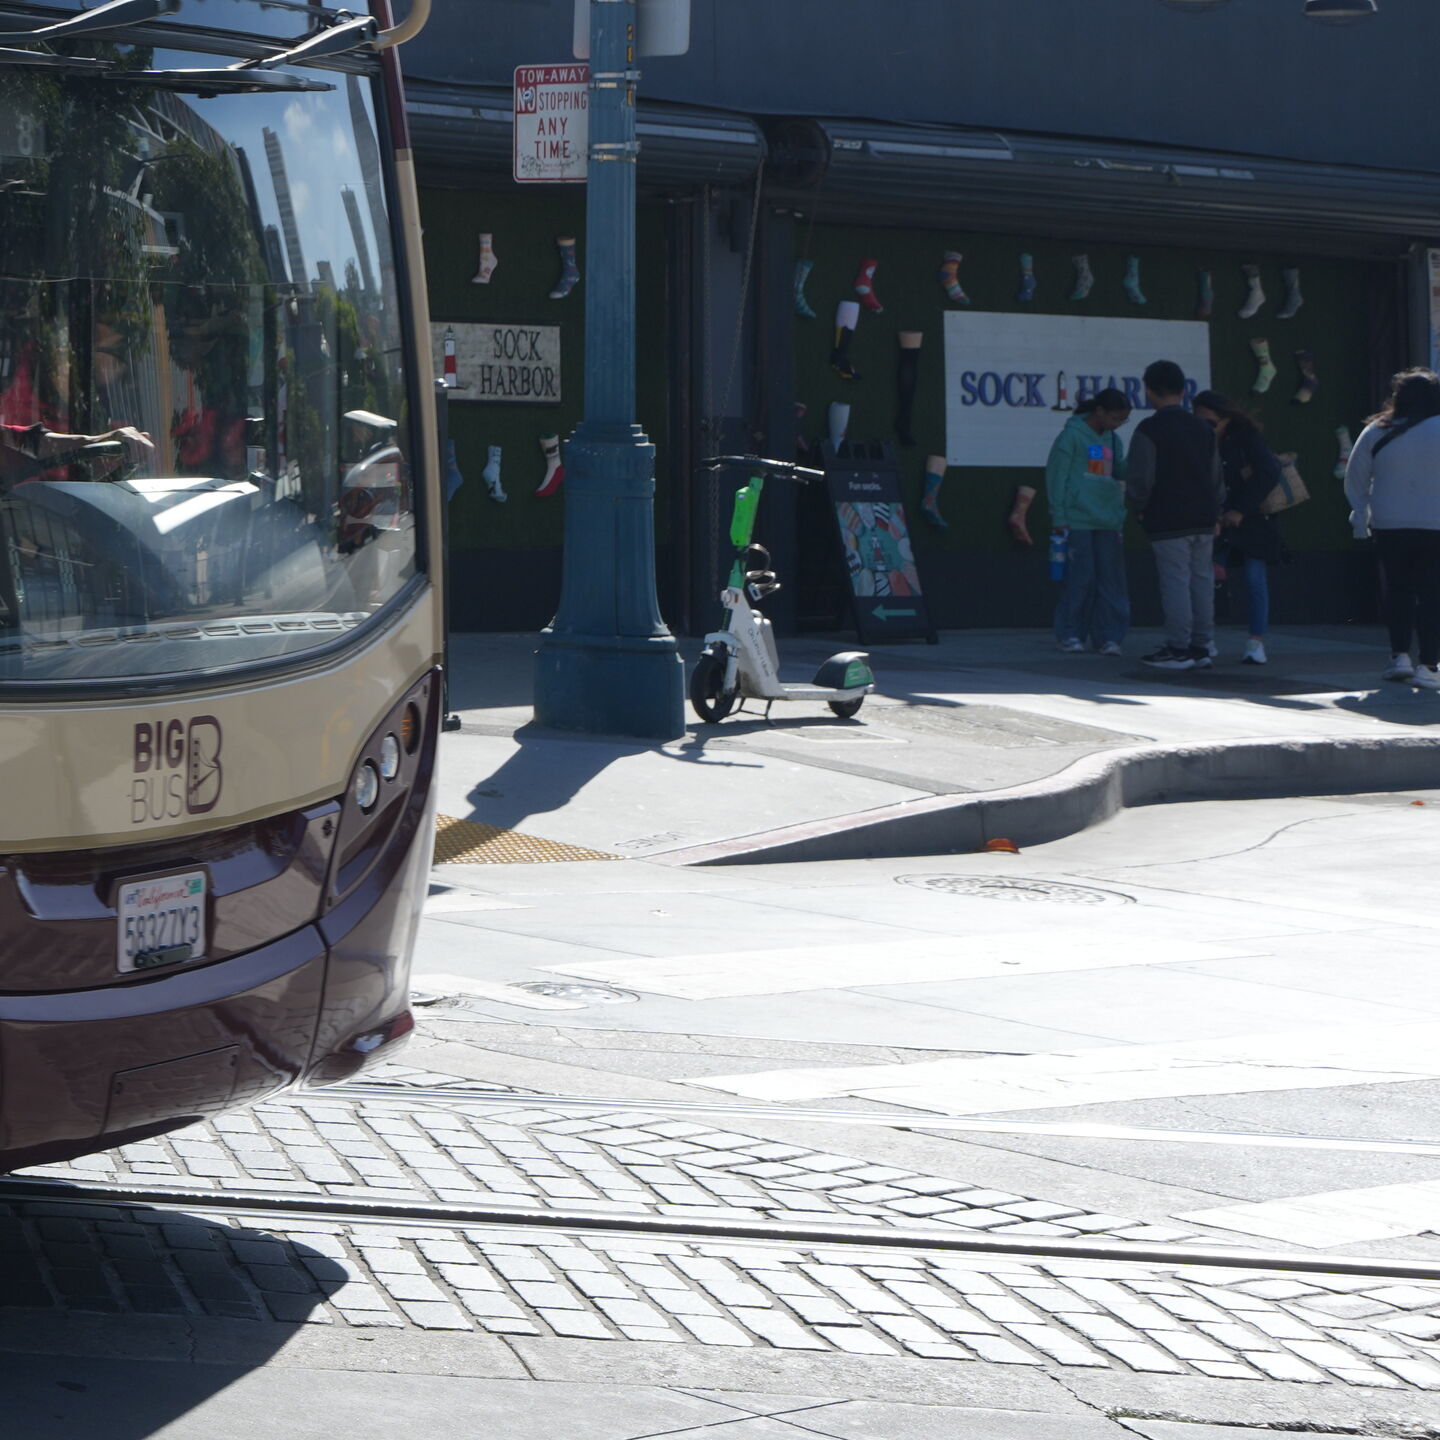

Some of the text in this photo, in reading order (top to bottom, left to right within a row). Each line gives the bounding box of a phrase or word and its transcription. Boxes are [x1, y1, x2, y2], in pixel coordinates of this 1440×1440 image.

[520, 68, 587, 84] TOW-AWAY
[539, 90, 587, 111] STOPPING
[537, 117, 568, 136] ANY
[534, 140, 571, 159] TIME
[493, 329, 542, 361] SOCK
[480, 364, 557, 397] HARBOR
[961, 371, 1047, 408] SOCK
[133, 718, 185, 774] BIG
[132, 773, 183, 824] BUS
